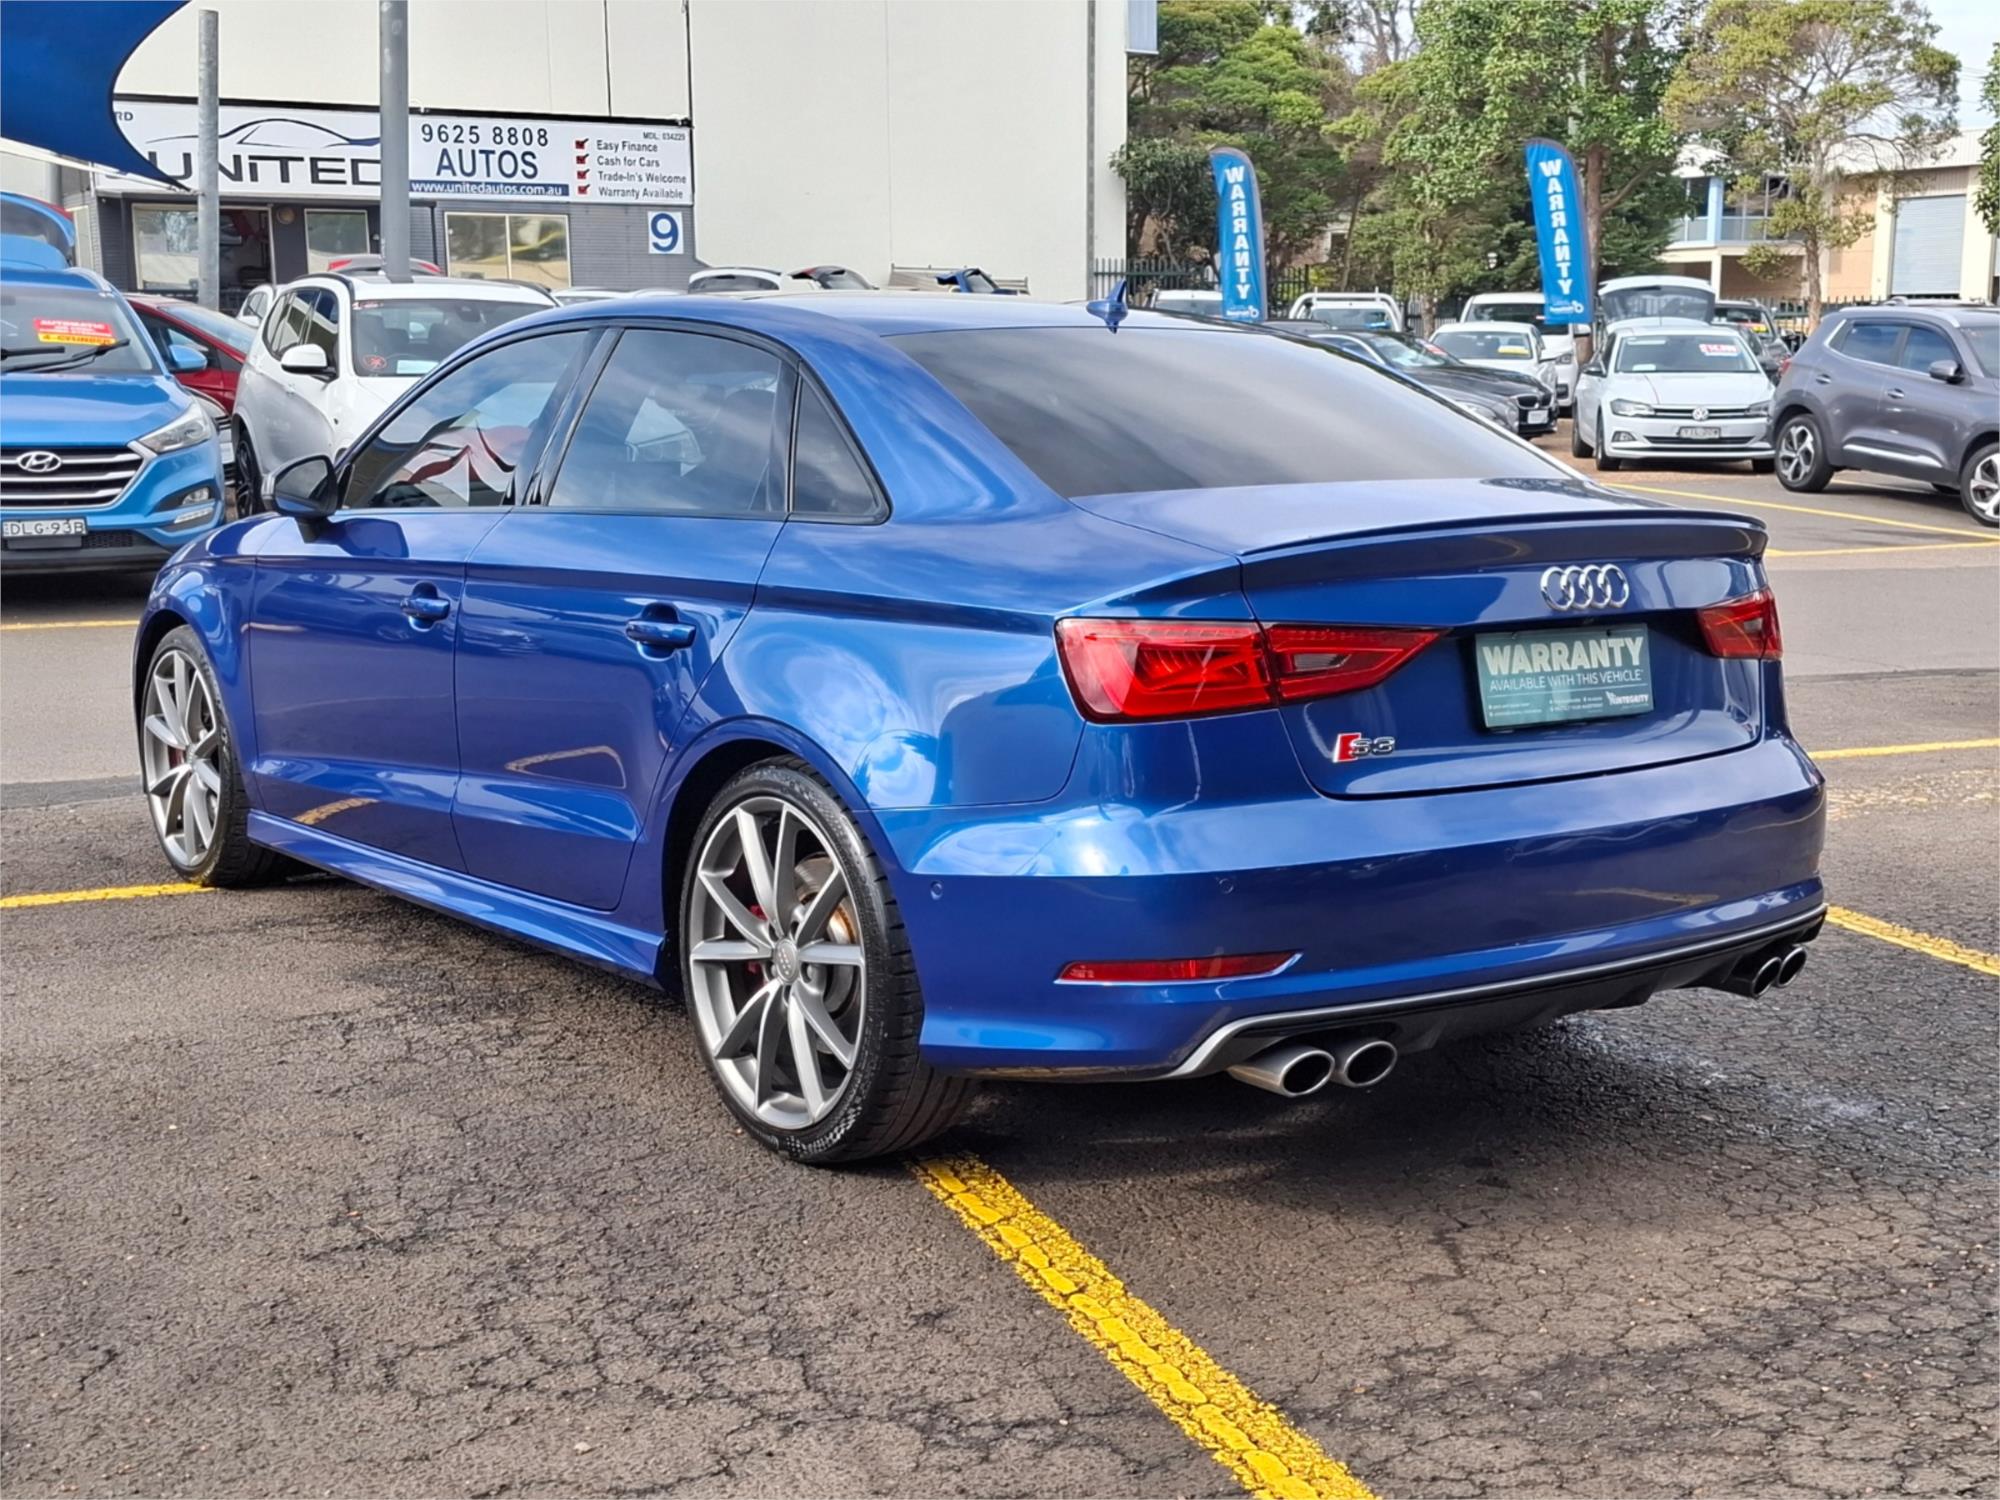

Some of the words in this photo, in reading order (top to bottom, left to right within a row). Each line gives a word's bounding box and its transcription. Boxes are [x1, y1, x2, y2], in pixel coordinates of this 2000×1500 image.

[421, 124, 480, 144] 9625
[492, 126, 548, 147] 8808
[597, 140, 619, 152] Easy
[621, 141, 658, 152] Finance
[436, 148, 538, 179] AUTOS
[597, 155, 621, 166] Cash
[623, 156, 636, 166] for
[639, 157, 660, 167] Cars
[598, 171, 643, 182] Trade-In's
[645, 173, 687, 184] Welcome
[411, 182, 562, 196] www.unitedautos.com.au
[598, 187, 640, 200] Warranty
[642, 188, 684, 199] Available
[650, 212, 679, 252] 9
[1482, 636, 1644, 675] WARRANTY
[1489, 675, 1546, 692] AVAILABLE
[1548, 673, 1575, 687] WITH
[1577, 672, 1599, 685] THIS
